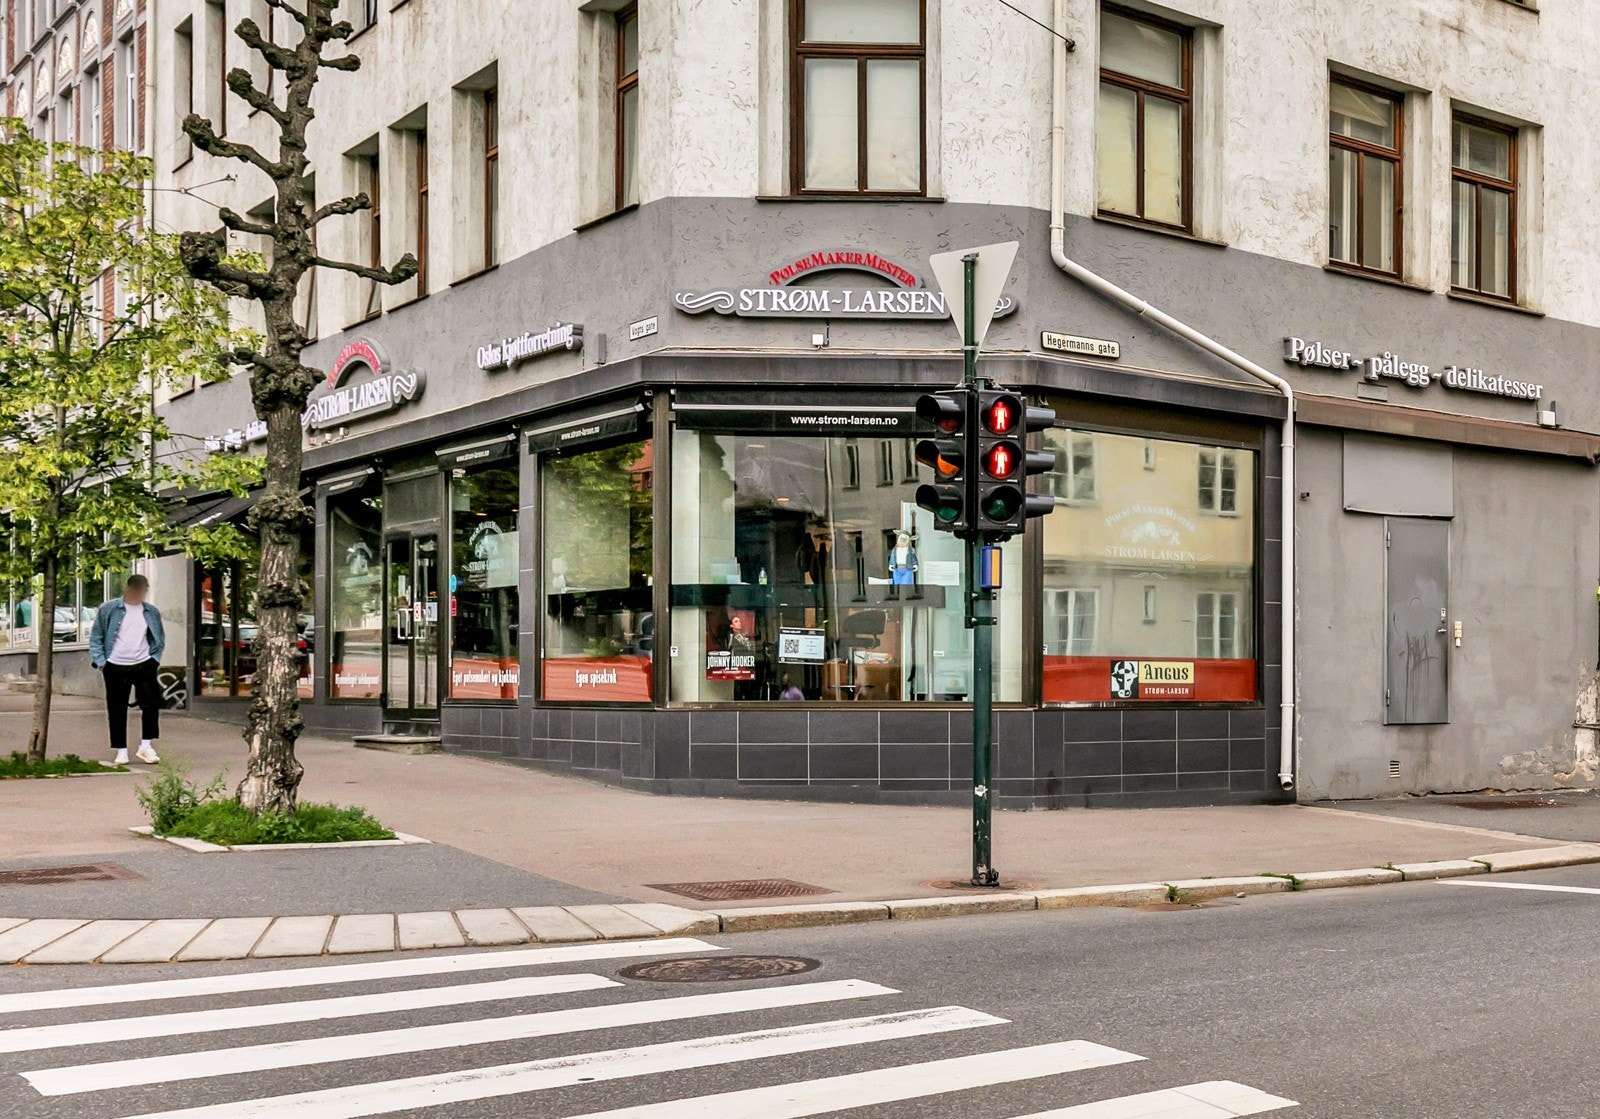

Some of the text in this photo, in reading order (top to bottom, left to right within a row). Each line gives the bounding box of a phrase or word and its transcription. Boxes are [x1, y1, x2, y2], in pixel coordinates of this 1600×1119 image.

[1047, 334, 1116, 354] Hegermanns gate
[1289, 336, 1351, 370] Pølser
[1369, 351, 1430, 386] pålegg
[1446, 365, 1544, 400] delikatesser
[790, 414, 899, 426] www.strom-larsen.no
[707, 655, 755, 670] JOHNNY HOOKER
[575, 668, 617, 688] Egen spisekrok
